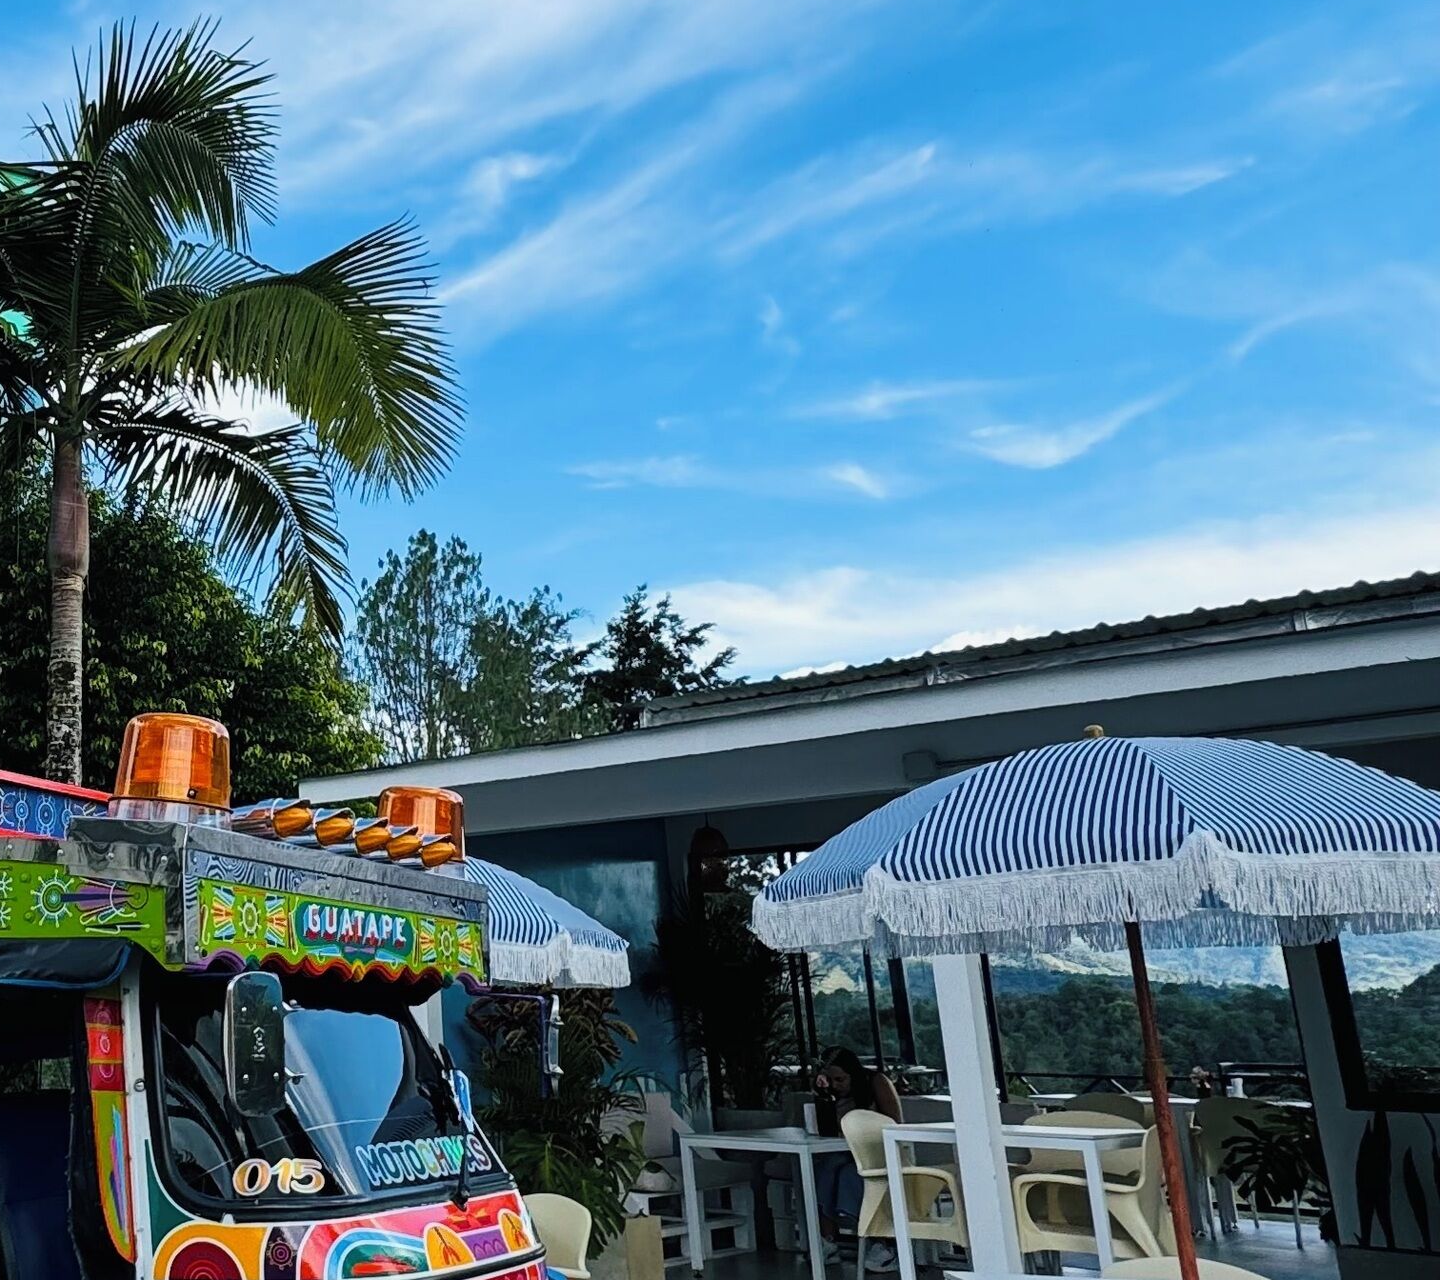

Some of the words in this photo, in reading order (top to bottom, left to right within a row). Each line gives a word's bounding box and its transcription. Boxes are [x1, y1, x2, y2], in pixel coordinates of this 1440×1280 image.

[303, 904, 407, 948] GUATAPE
[232, 1158, 325, 1196] 015
[355, 1134, 492, 1186] MOTOCHIVAS
